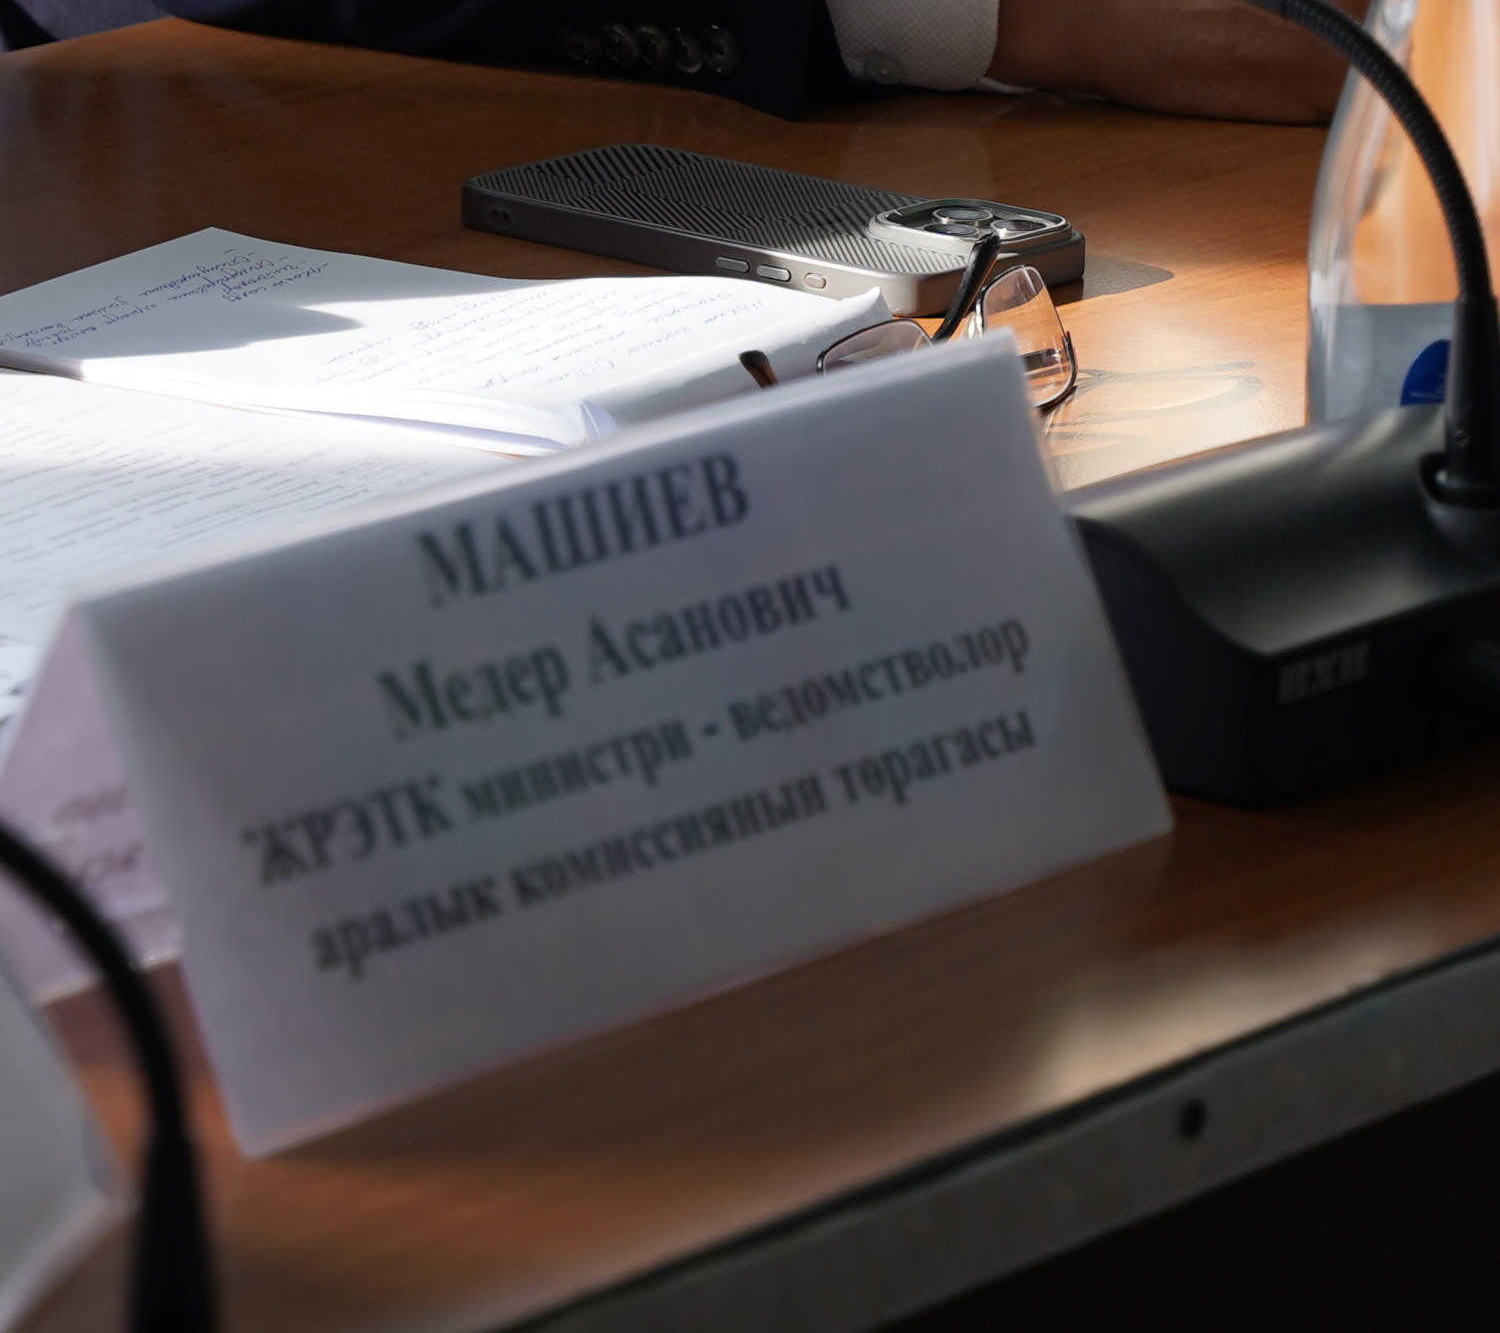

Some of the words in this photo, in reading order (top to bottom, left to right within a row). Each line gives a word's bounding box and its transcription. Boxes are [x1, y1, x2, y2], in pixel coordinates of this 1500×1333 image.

[417, 452, 752, 610] МАШИЕВ
[377, 638, 572, 743] Медер
[582, 565, 850, 685] Асанович
